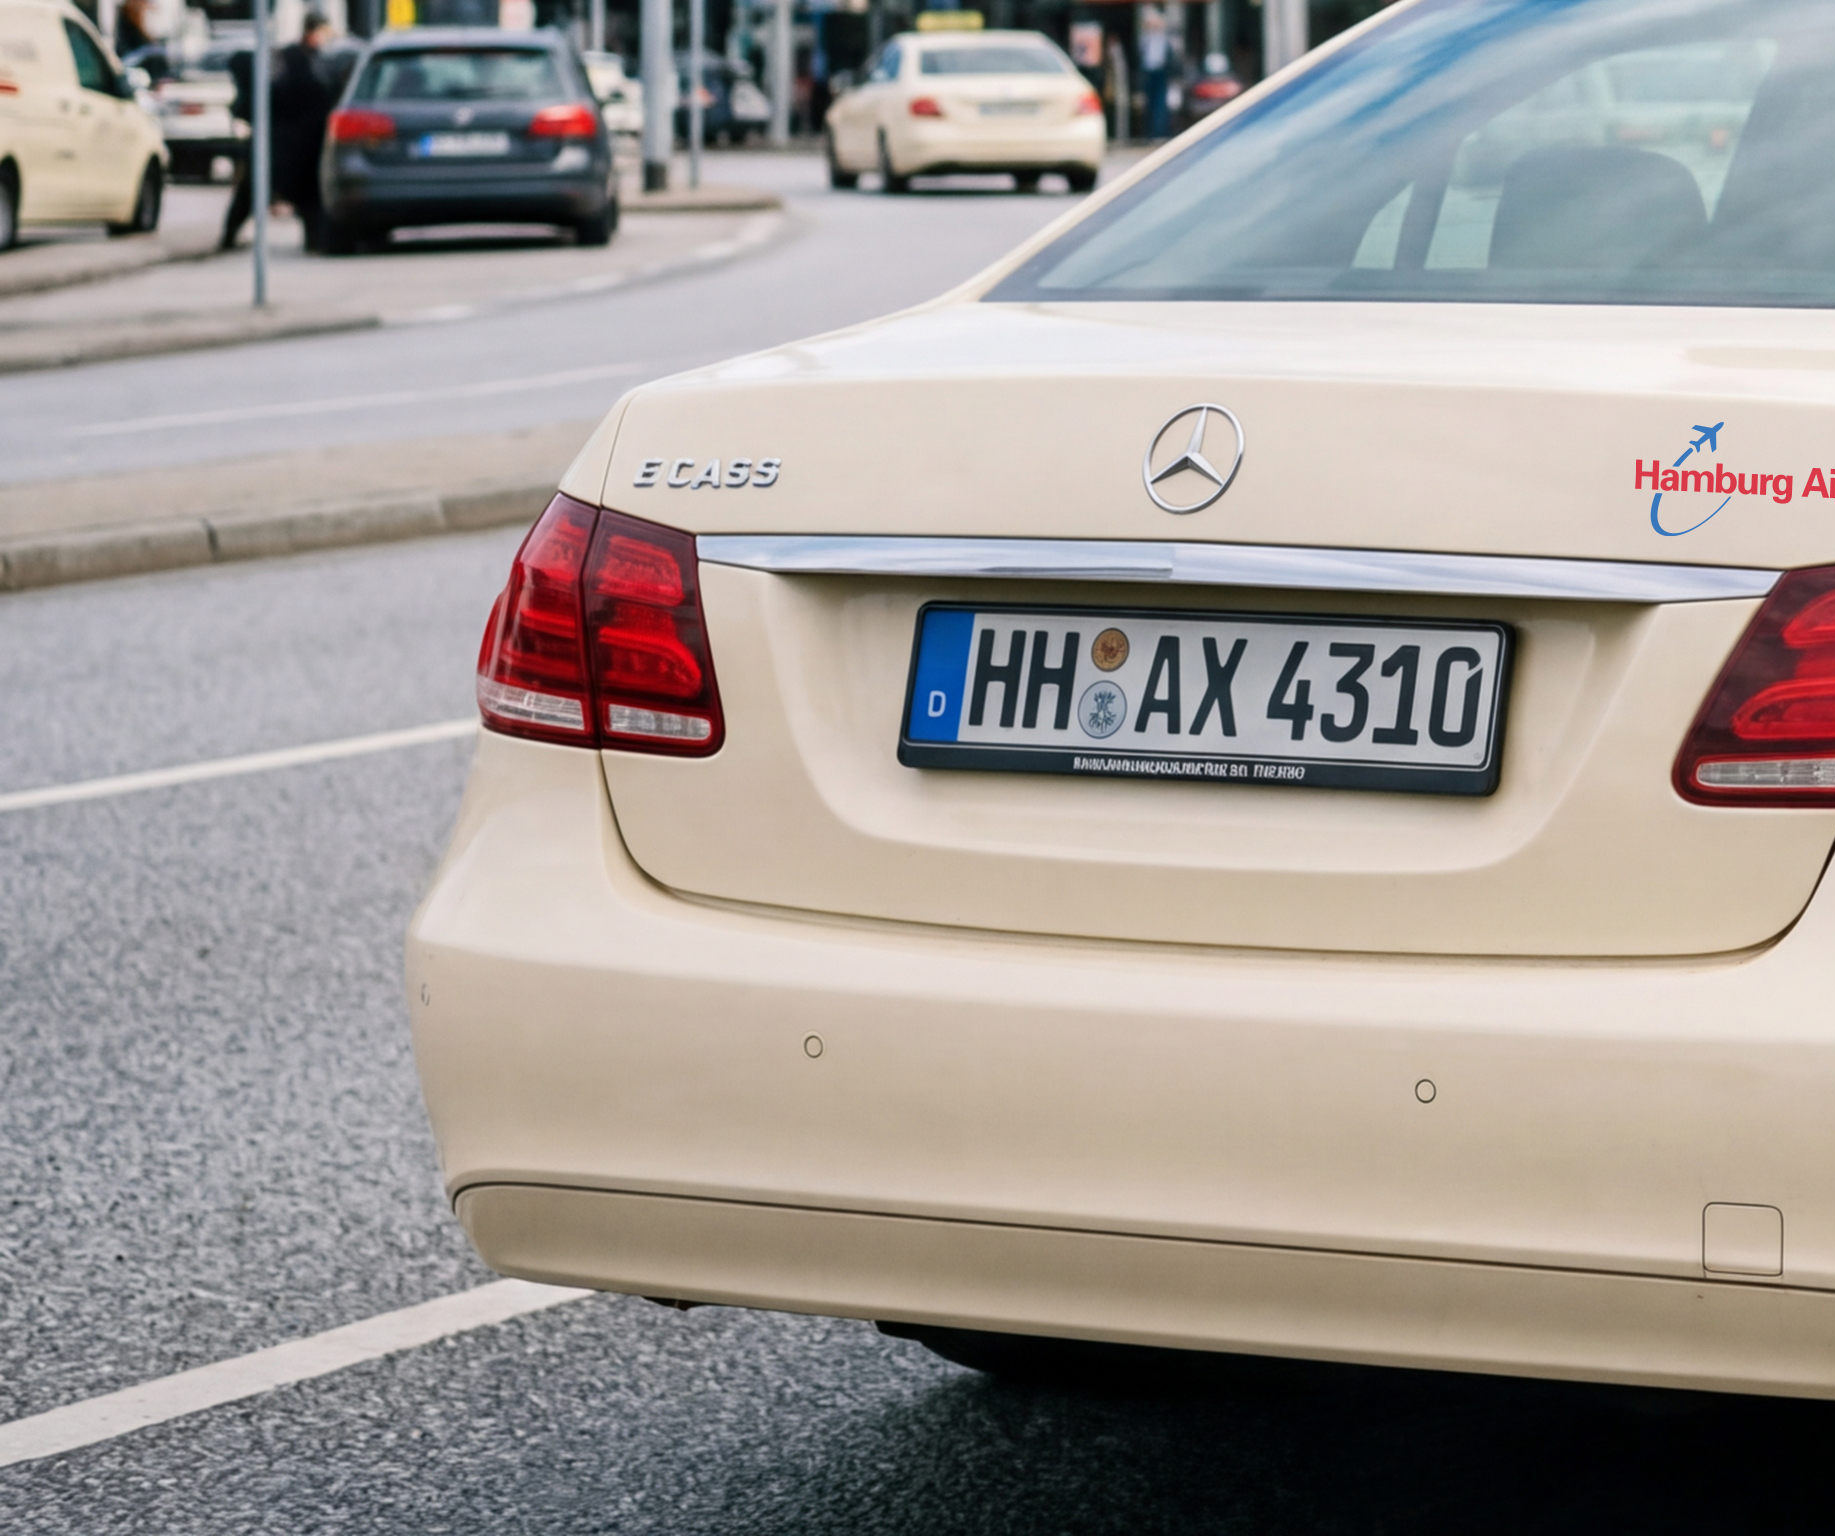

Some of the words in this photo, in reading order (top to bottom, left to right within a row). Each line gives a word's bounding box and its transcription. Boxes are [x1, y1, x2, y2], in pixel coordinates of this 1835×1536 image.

[1633, 458, 1795, 506] Hamburg
[927, 690, 946, 718] D
[967, 627, 1082, 732] HH
[1133, 634, 1250, 739] AX
[1265, 640, 1484, 749] 4310
